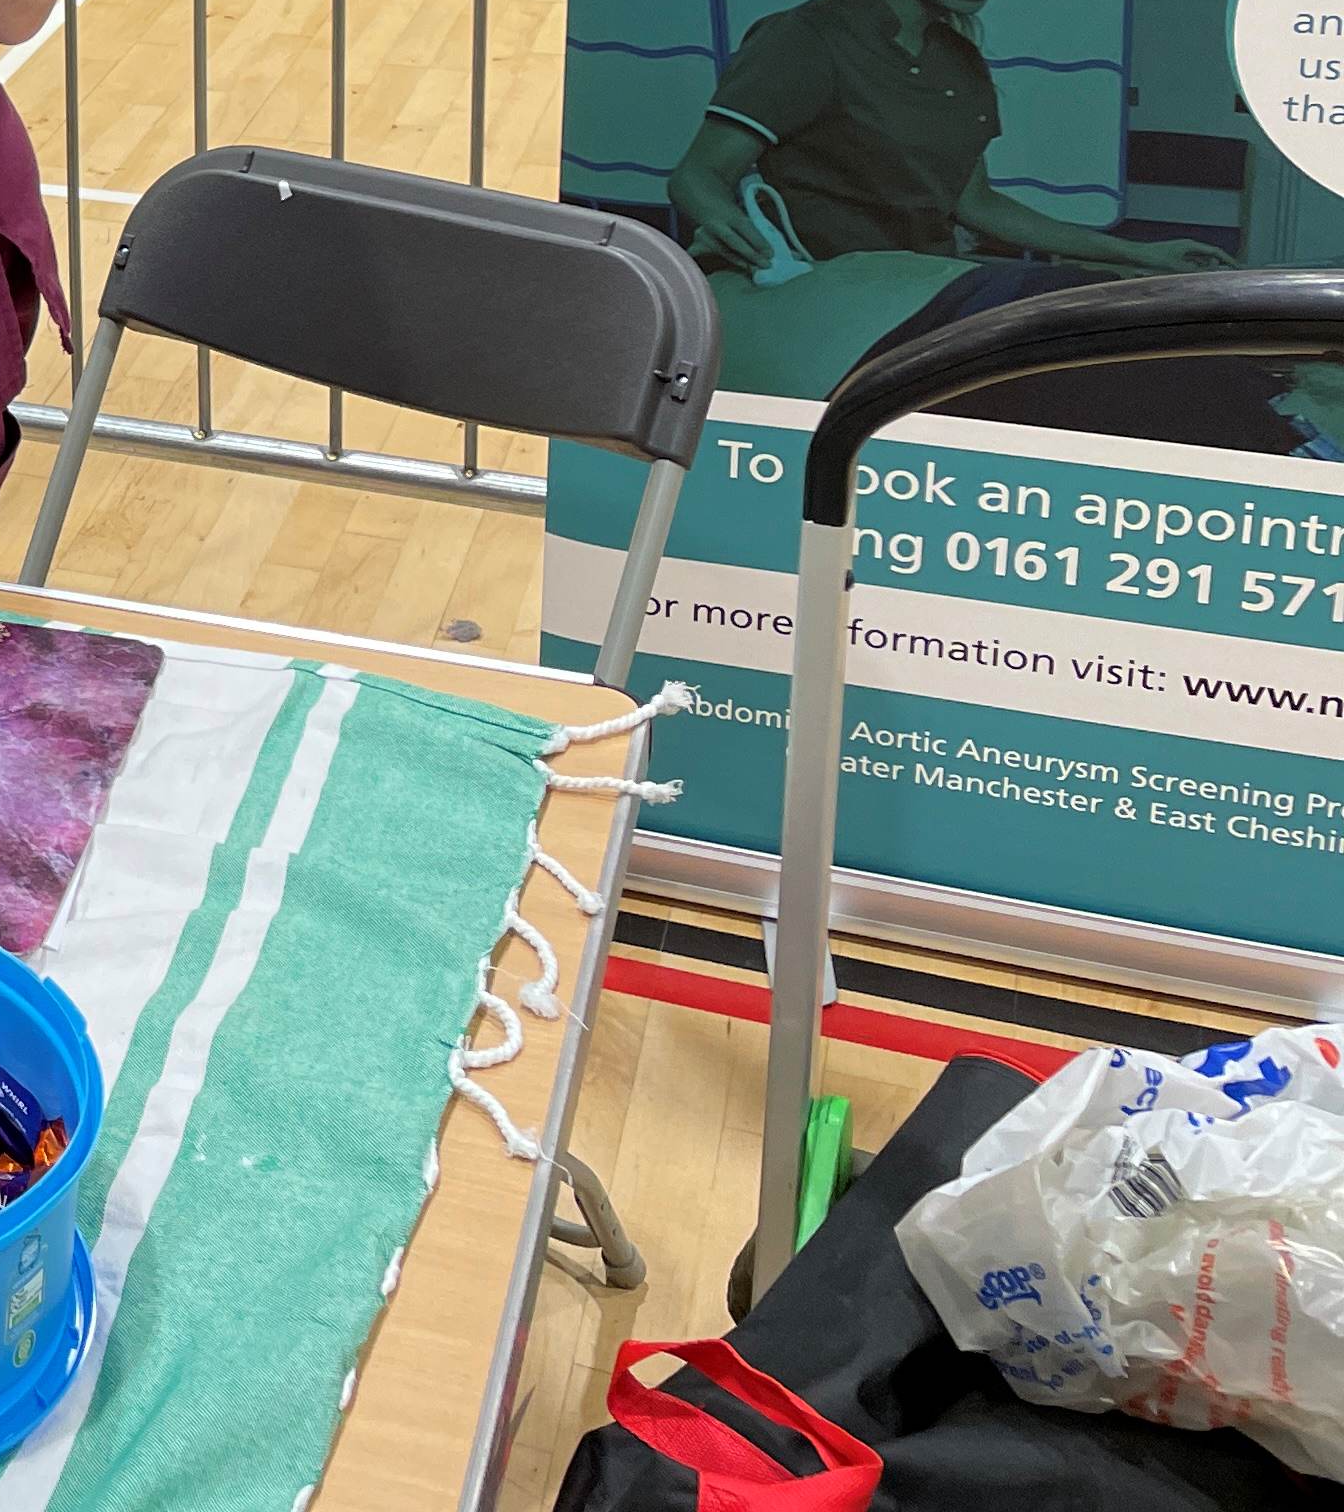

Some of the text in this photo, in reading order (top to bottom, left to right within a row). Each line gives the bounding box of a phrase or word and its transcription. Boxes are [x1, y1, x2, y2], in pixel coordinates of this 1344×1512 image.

[717, 439, 784, 483] To
[977, 481, 1051, 519] an
[852, 528, 923, 574] ng
[946, 531, 1079, 586] 0161
[1105, 552, 1212, 605] 291
[693, 603, 794, 636] more
[847, 620, 1056, 675] formation
[1071, 654, 1166, 692] visit:
[849, 721, 948, 756] Aortic
[957, 738, 1119, 785] Aneurysm
[1130, 766, 1294, 822] Screening
[914, 758, 1104, 814] Manchester
[1114, 797, 1137, 820] &
[1149, 801, 1217, 835] East
[2, 1082, 29, 1115] WHIRL
